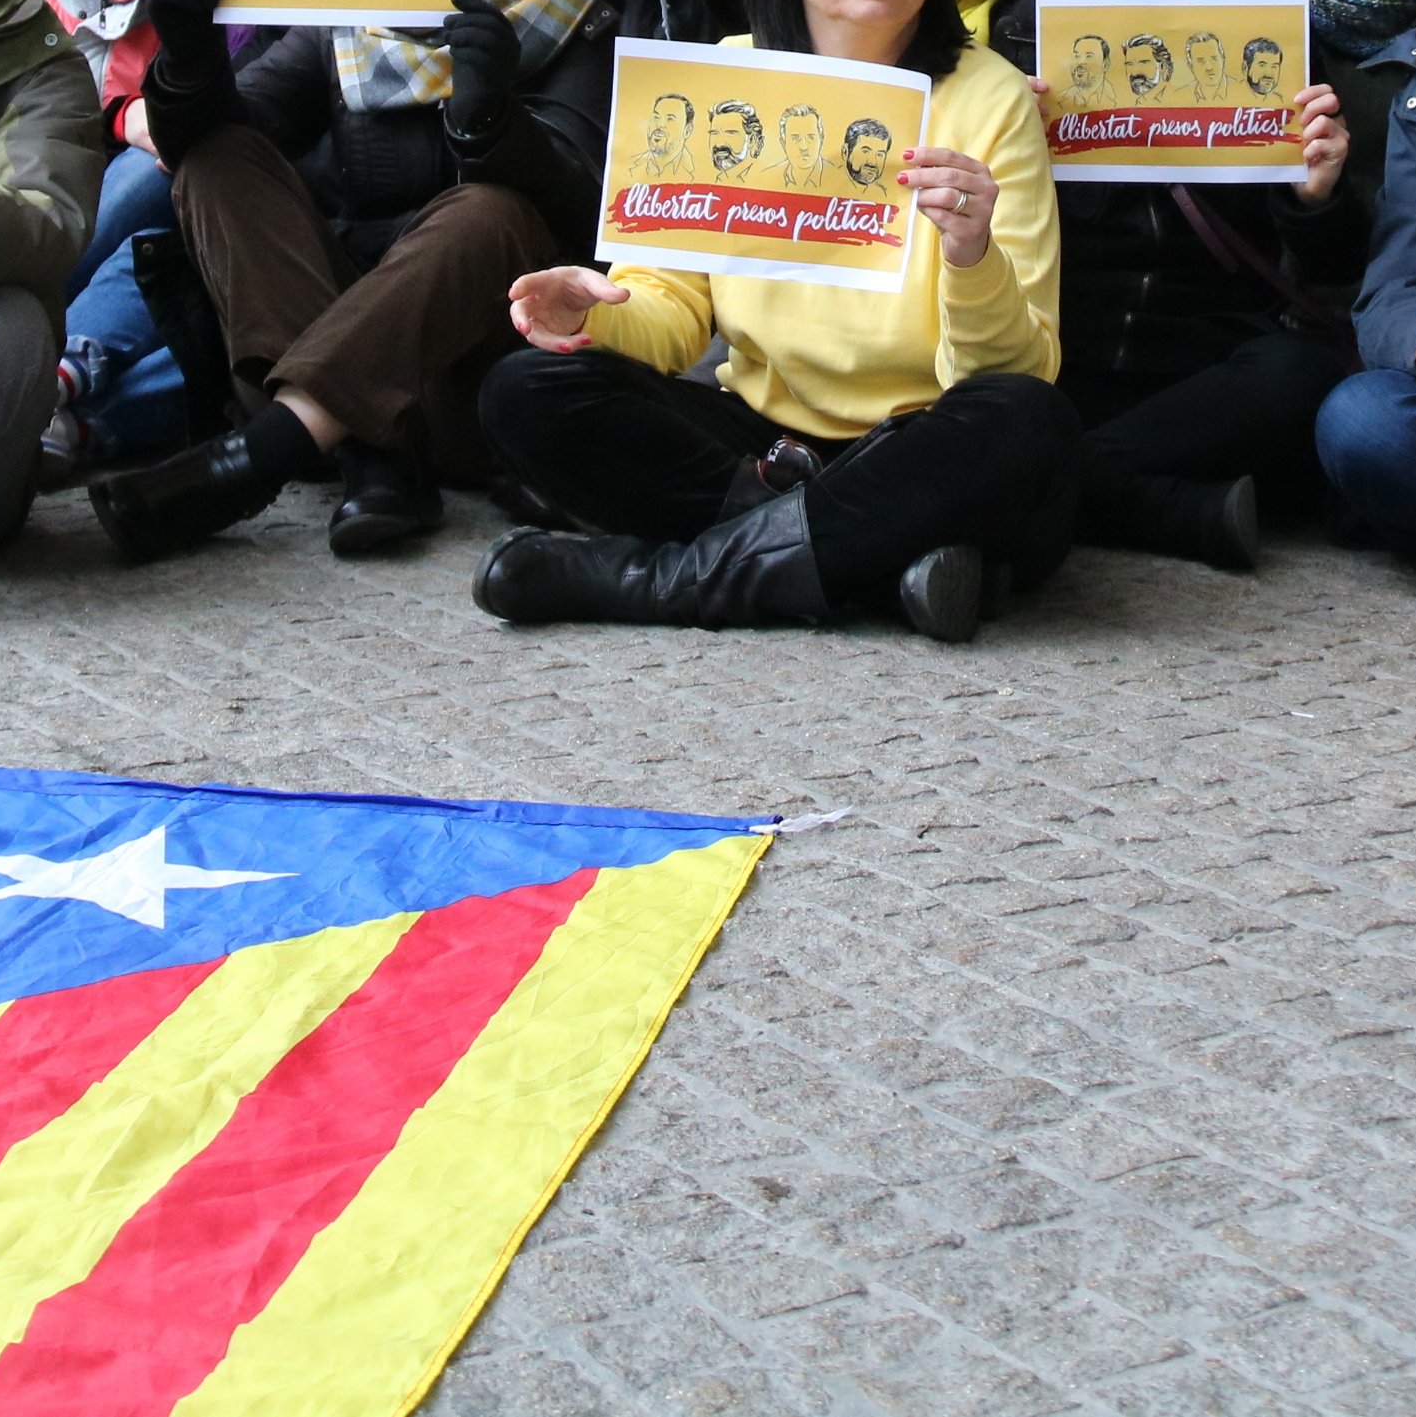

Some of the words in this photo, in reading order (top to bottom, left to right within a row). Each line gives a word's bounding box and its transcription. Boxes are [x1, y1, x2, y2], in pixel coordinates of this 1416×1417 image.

[1057, 112, 1143, 142] llibertat
[1147, 117, 1202, 148] presos
[623, 182, 722, 221] llibertat
[724, 201, 789, 234] presos
